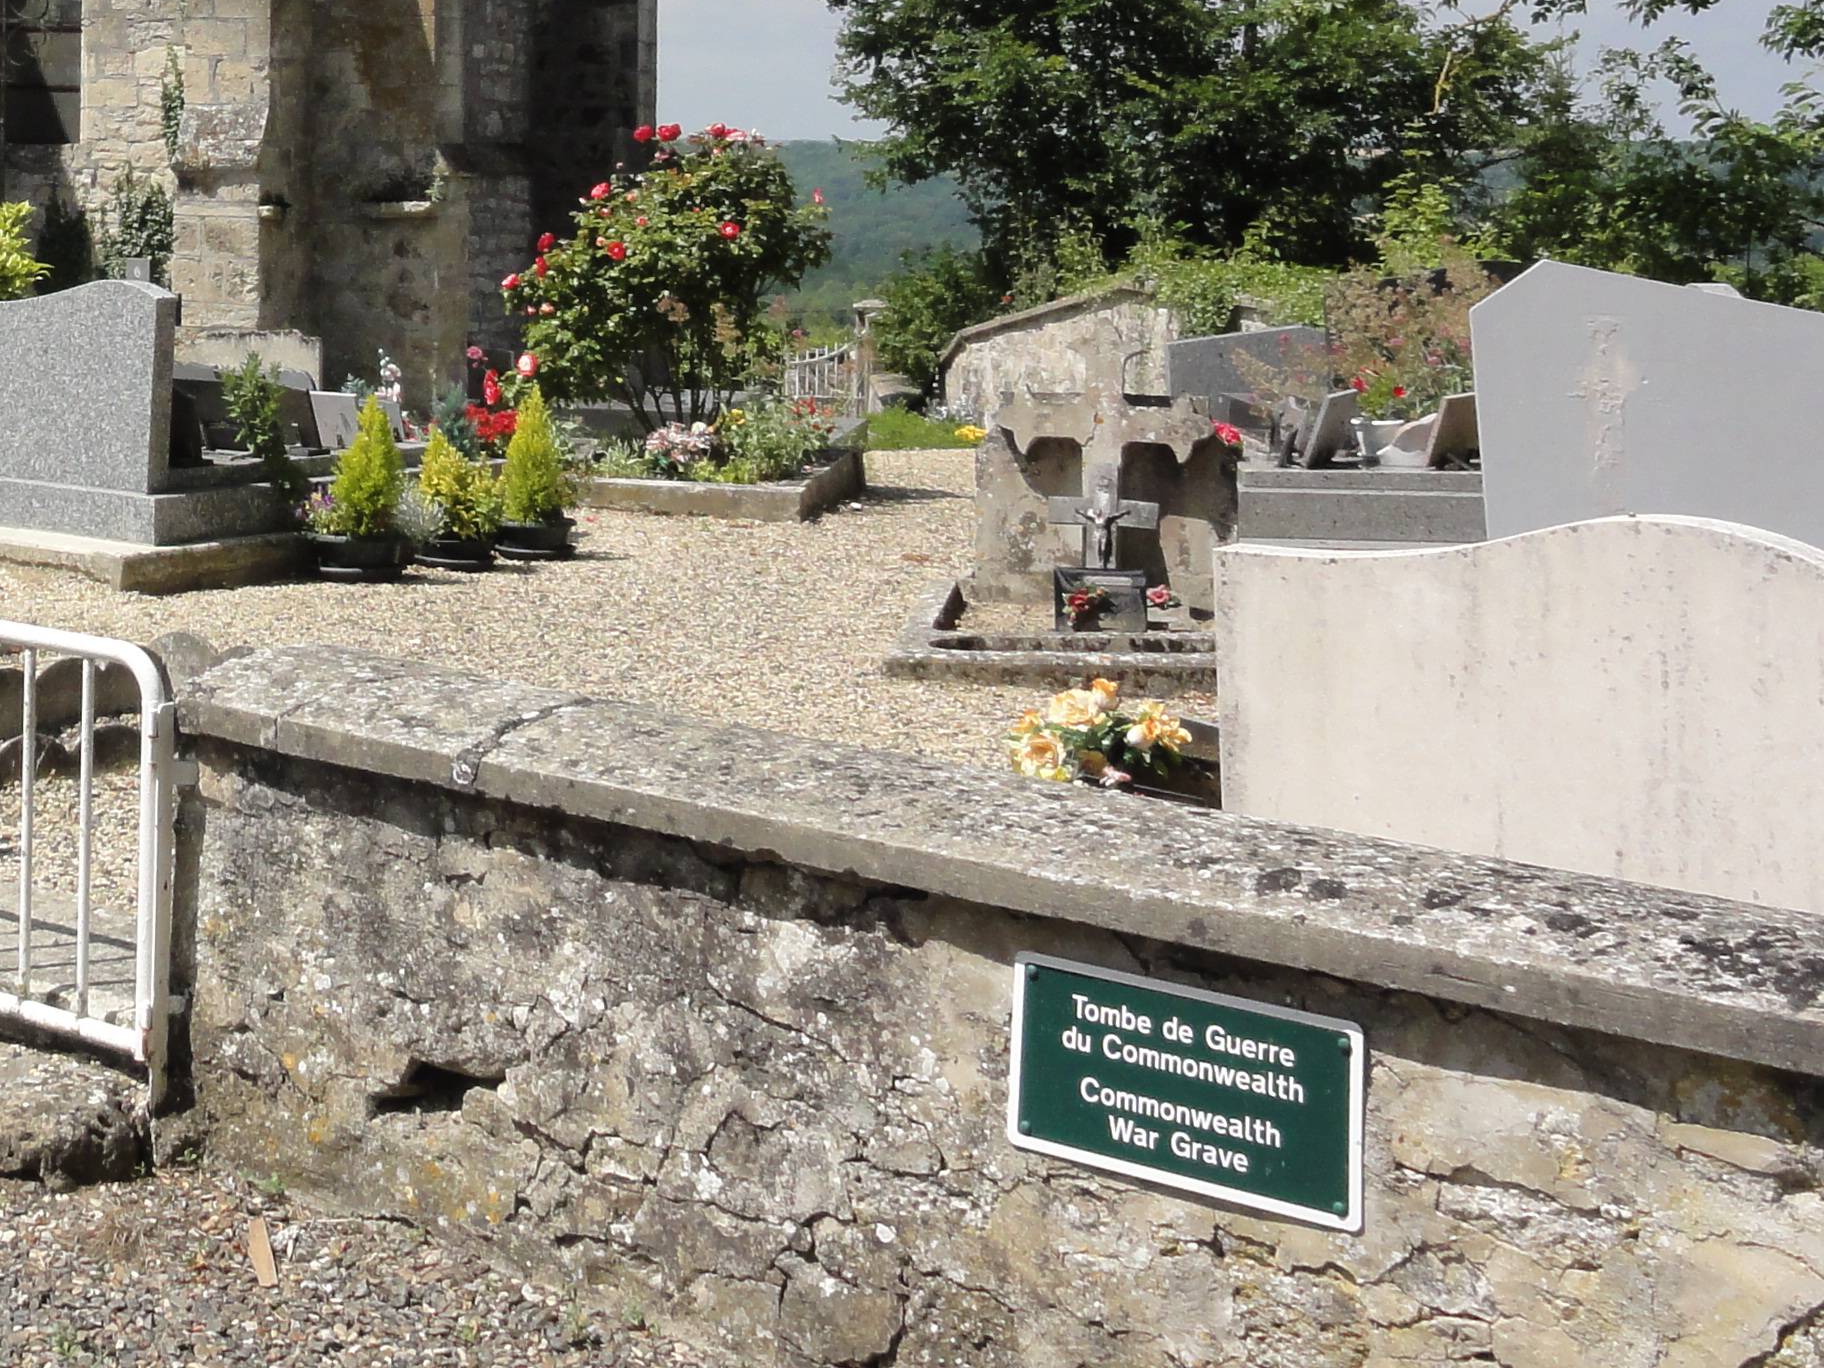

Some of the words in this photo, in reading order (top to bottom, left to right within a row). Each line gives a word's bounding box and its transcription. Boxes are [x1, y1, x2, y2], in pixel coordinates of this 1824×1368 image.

[1062, 1025, 1091, 1053] du
[1102, 1033, 1304, 1103] Commonwealth
[1071, 993, 1152, 1034] Tombe
[1162, 1016, 1194, 1044] de
[1205, 1024, 1295, 1067] Guerre
[1080, 1076, 1281, 1148] Commonwealth
[1108, 1114, 1159, 1150] War
[1171, 1131, 1249, 1173] Grave
